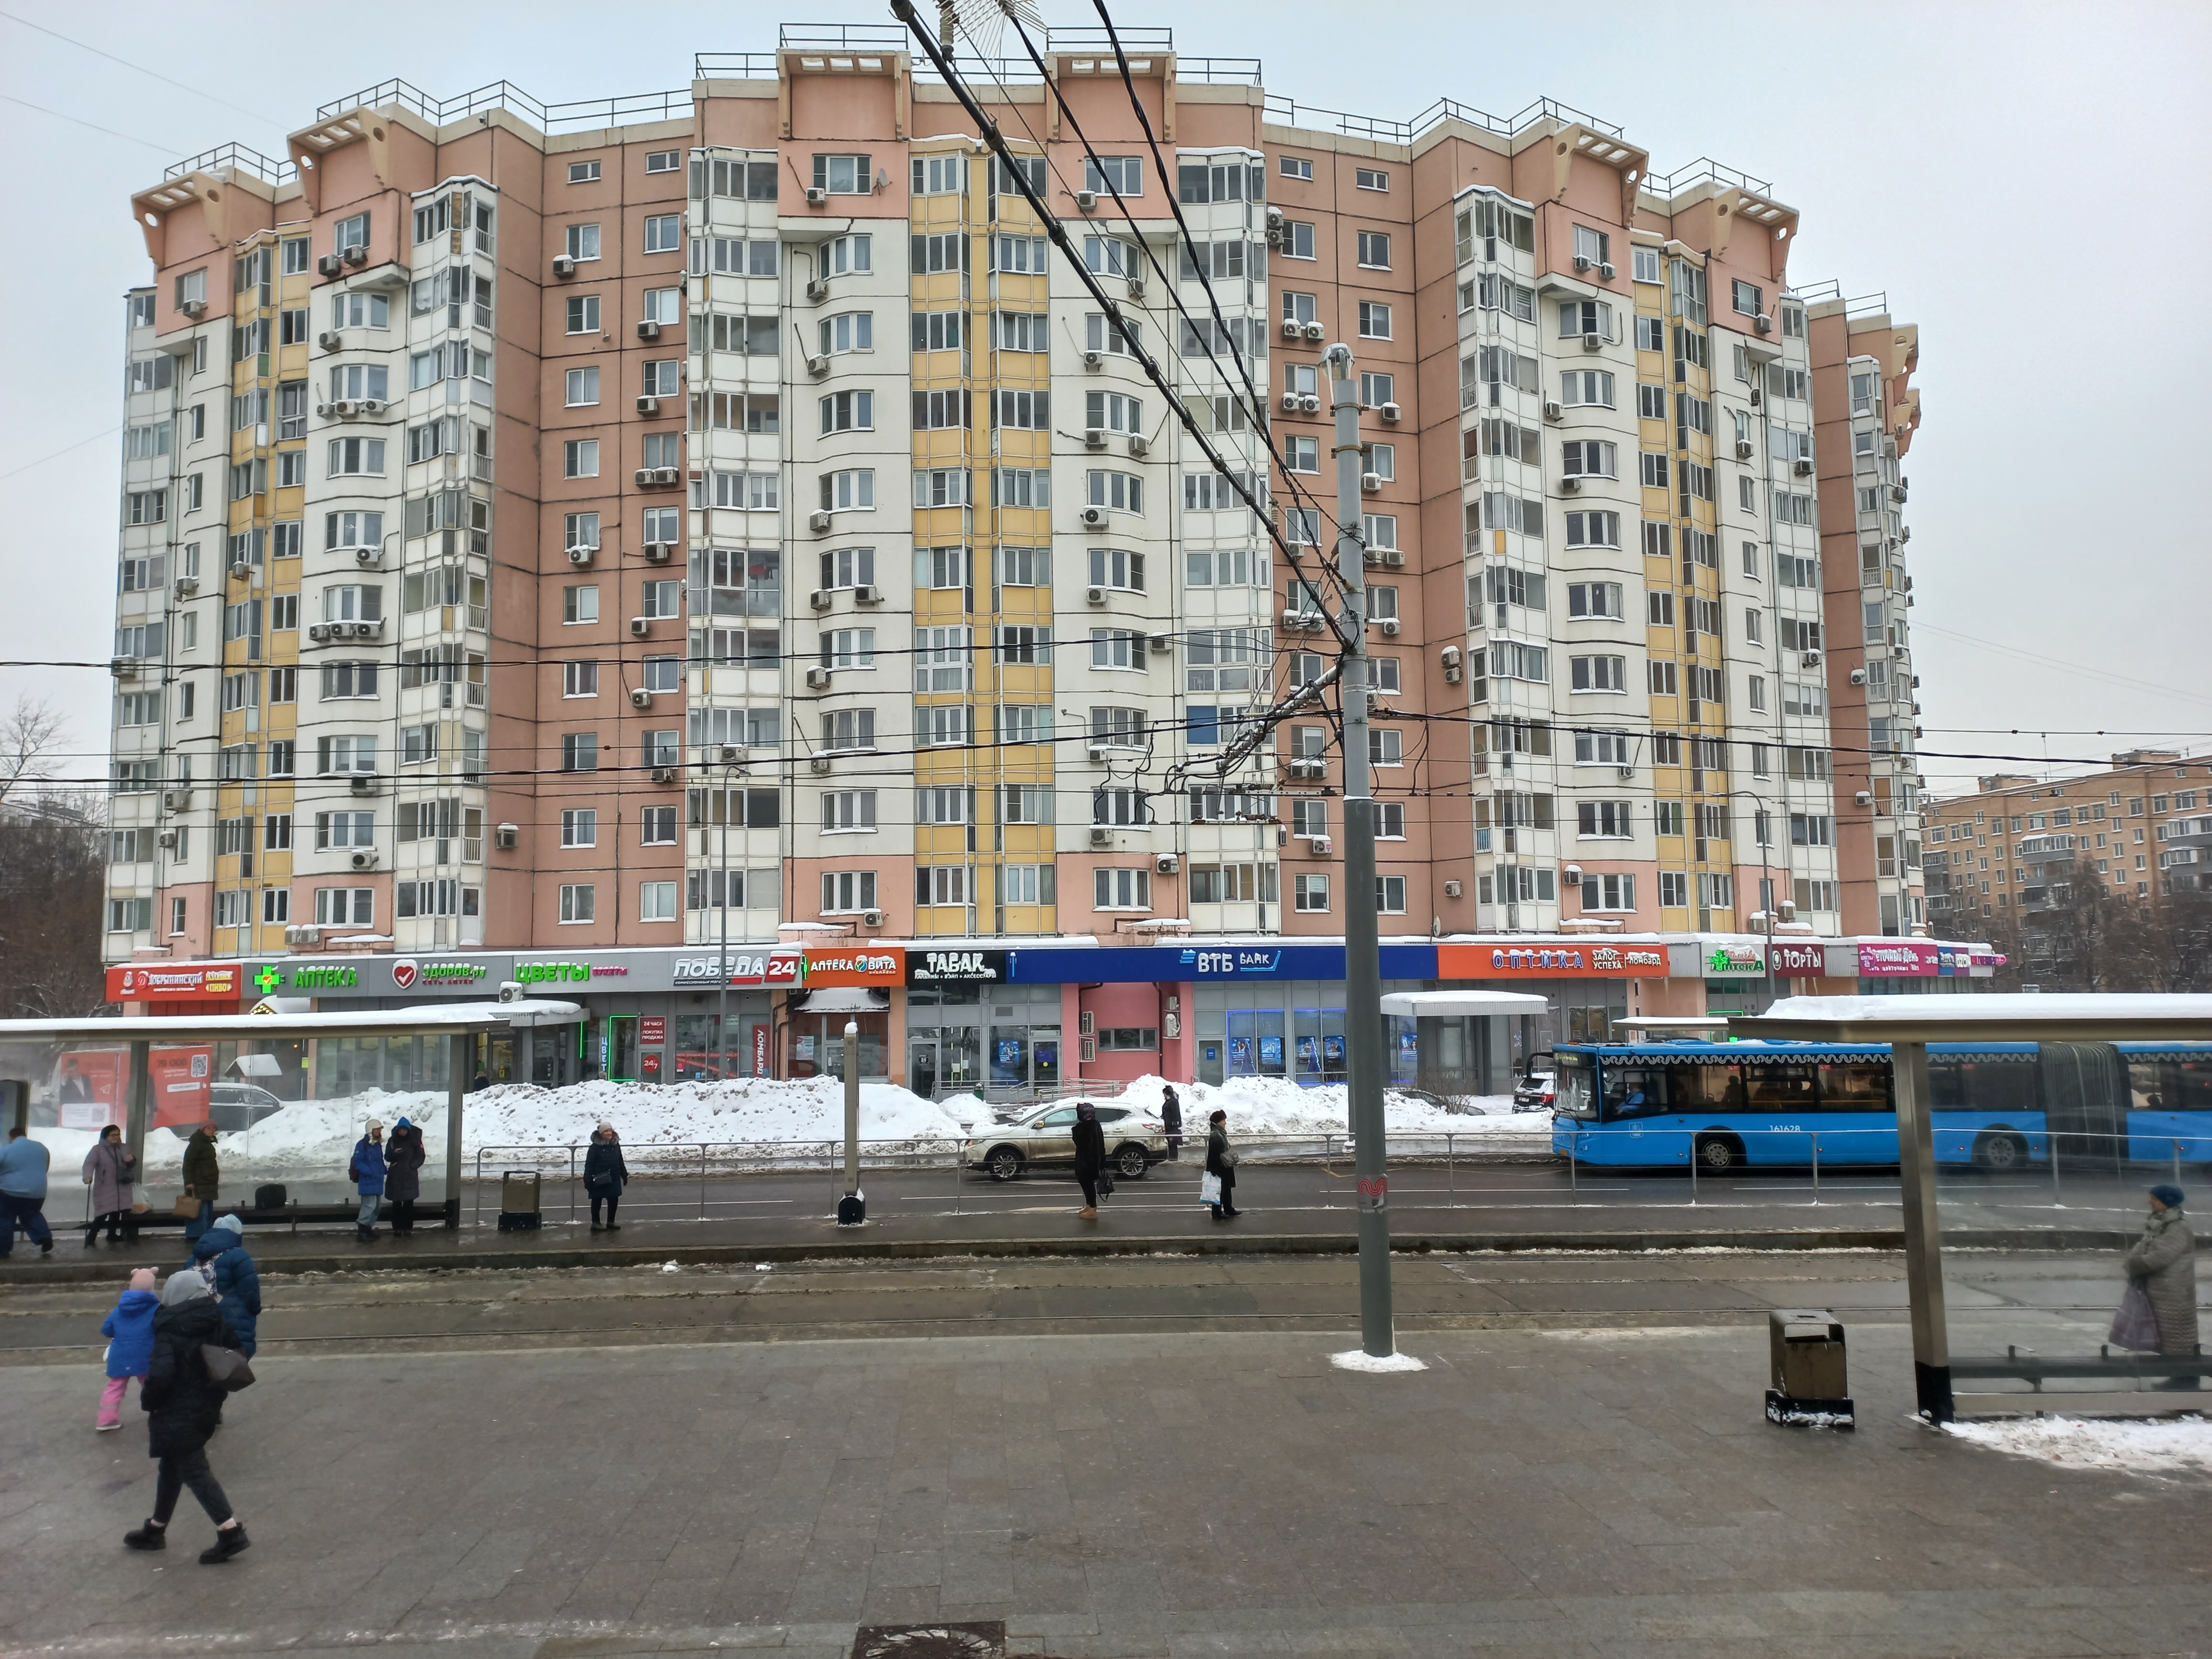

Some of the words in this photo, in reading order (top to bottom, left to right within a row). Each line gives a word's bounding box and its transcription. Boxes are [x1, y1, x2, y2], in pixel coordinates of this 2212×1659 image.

[810, 959, 854, 971] АПТЕКА
[868, 959, 896, 970] ВИТА
[927, 953, 984, 973] ТАБАК
[1198, 953, 1234, 973] ВТБ
[1240, 952, 1270, 964] БАНК
[1493, 951, 1583, 969] ОПТИКА
[1593, 952, 1617, 961] ЗАЛОГ
[1593, 961, 1622, 969] УСПЕХА
[1629, 955, 1661, 966] ломбард
[1784, 950, 1822, 968] ТОРТЫ
[516, 962, 589, 984] ЦВЕТЫ
[592, 967, 627, 976] БУКЕТЫ
[673, 956, 765, 977] ПОБЕДА
[769, 961, 796, 975] 24
[295, 966, 357, 987] АПТЕКА
[644, 1060, 658, 1069] 24/7
